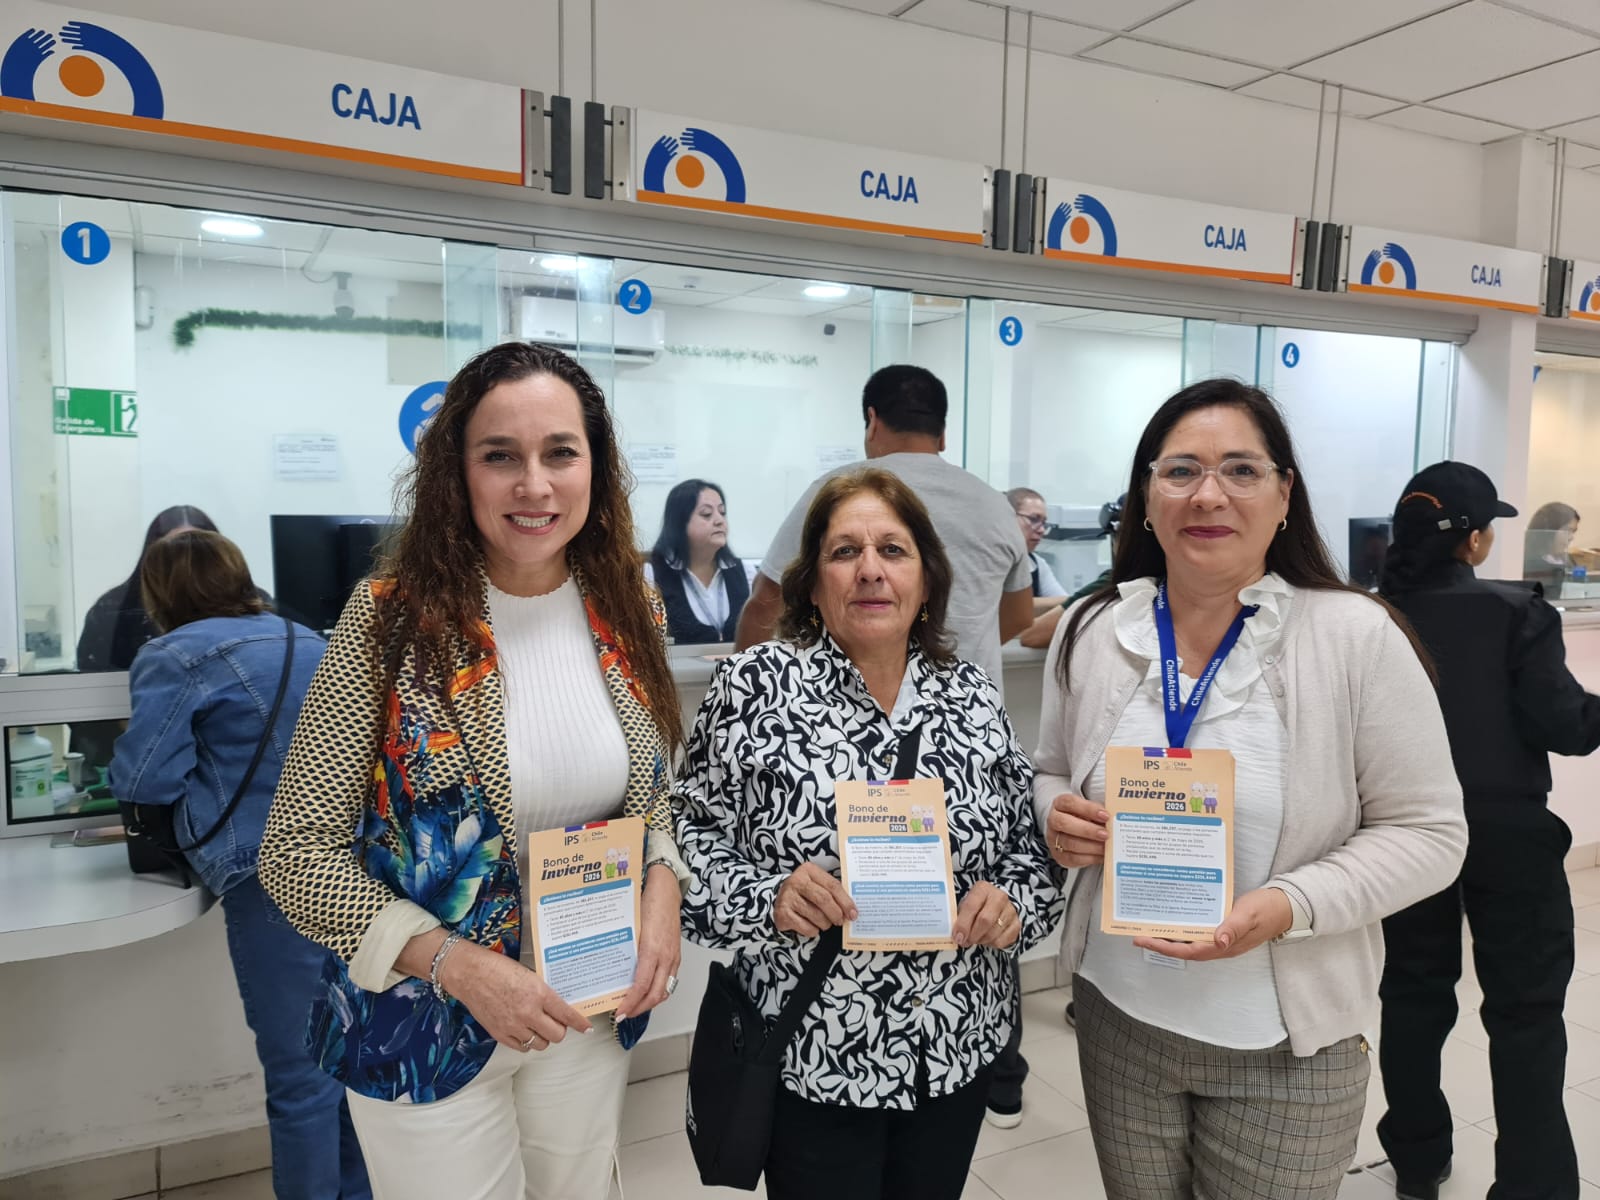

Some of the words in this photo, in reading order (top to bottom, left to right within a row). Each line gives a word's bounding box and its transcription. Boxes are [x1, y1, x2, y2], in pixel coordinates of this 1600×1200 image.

[332, 83, 421, 130] CAJA
[860, 170, 919, 204] CAJA
[77, 228, 90, 258] 1
[1204, 224, 1247, 252] CAJA
[1470, 264, 1502, 288] CAJA
[628, 284, 641, 309] 2
[1005, 320, 1015, 342] 3
[1285, 345, 1295, 365] 4
[1166, 659, 1178, 712] ChileAtiende
[1143, 760, 1160, 770] IPS
[1120, 777, 1149, 787] Bono
[1151, 779, 1166, 788] de
[868, 788, 882, 797] IPS
[1118, 787, 1186, 801] Invierno
[848, 804, 873, 813] Bono
[876, 804, 889, 813] de
[1166, 802, 1185, 811] 2026
[848, 813, 907, 823] Invierno
[890, 824, 907, 832] 2026
[564, 834, 579, 846] IPS
[543, 857, 569, 868] Bono
[571, 853, 585, 864] de
[541, 861, 602, 881] Invierno
[584, 871, 601, 882] 2026
